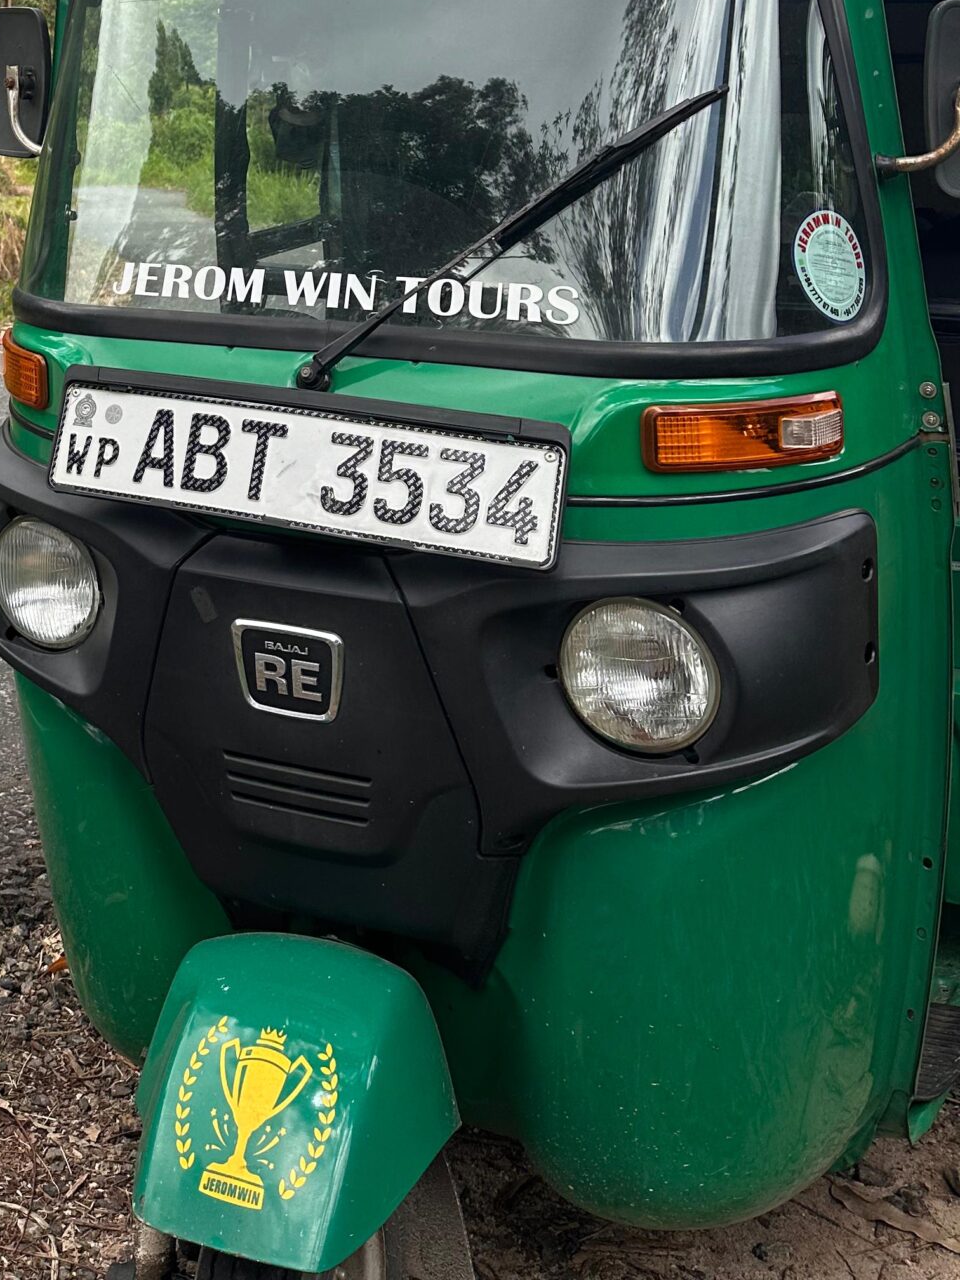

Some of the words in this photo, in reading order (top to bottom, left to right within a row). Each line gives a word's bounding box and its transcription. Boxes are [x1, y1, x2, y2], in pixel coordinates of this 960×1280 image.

[844, 226, 863, 269] TOURS
[113, 261, 266, 304] JEROM
[283, 269, 377, 311] WIN
[395, 276, 580, 325] TOURS
[66, 433, 120, 478] WP
[133, 408, 289, 501] ABT
[320, 431, 540, 545] 3534
[264, 640, 308, 656] BAJAJ
[254, 652, 322, 702] RE
[203, 1177, 261, 1206] JEROMWIN
